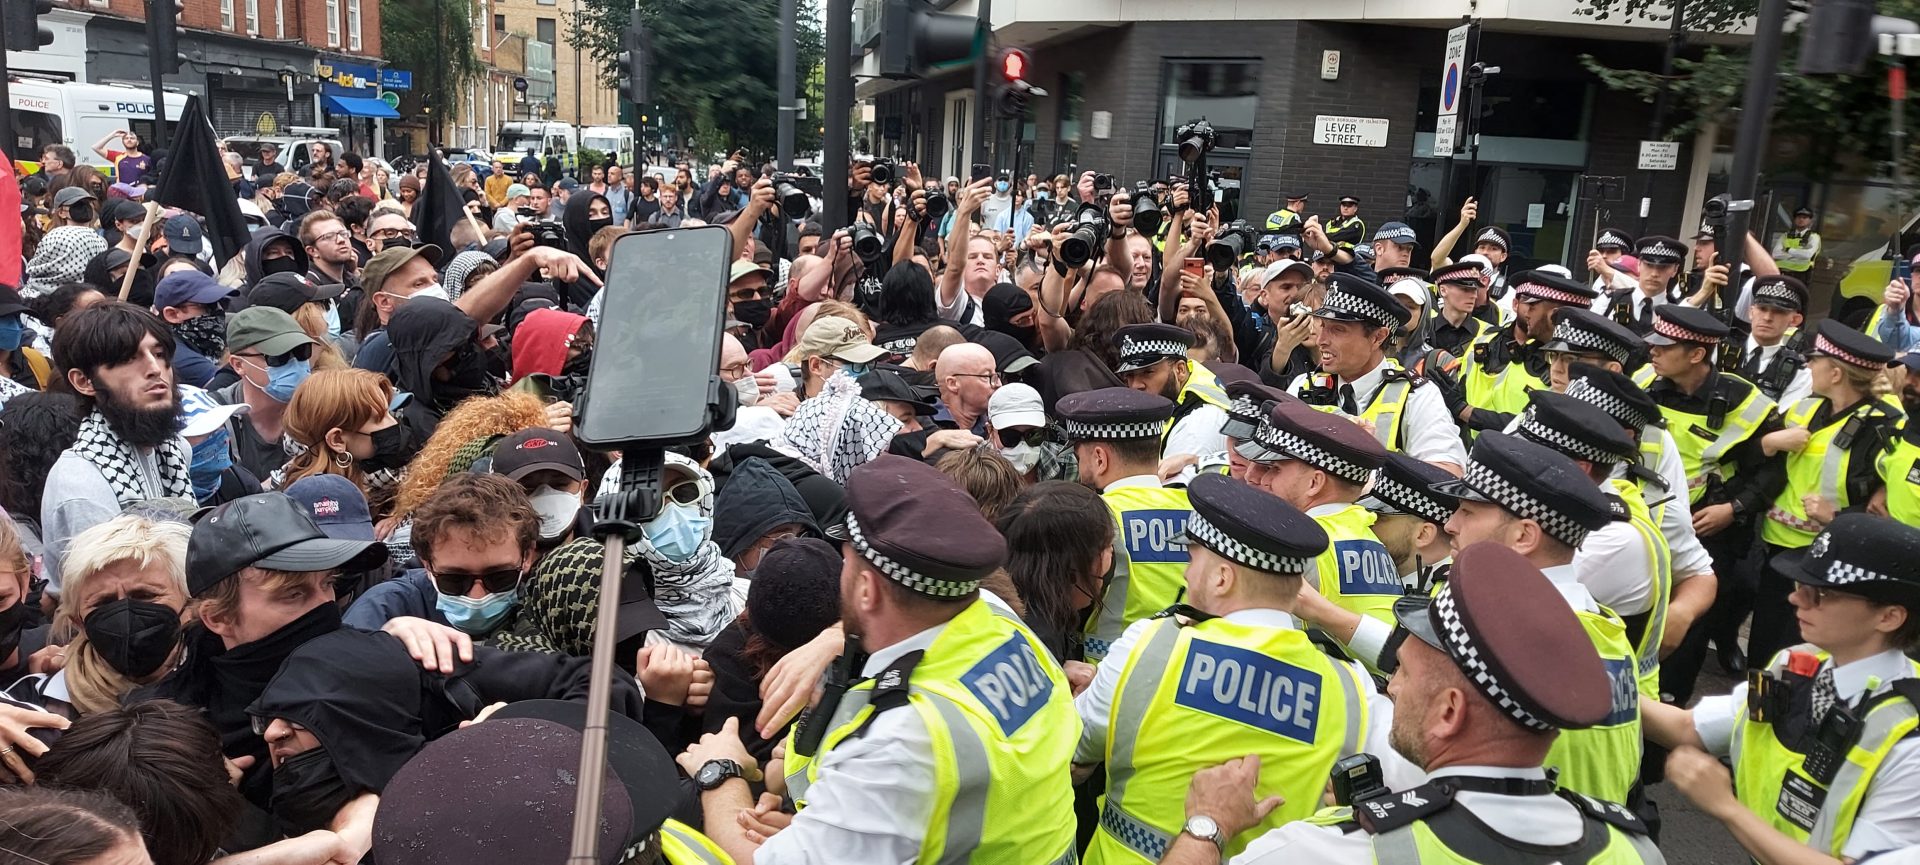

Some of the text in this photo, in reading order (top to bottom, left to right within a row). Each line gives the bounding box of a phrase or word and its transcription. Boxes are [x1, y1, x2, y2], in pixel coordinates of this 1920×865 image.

[1448, 45, 1462, 60] ZONE
[18, 98, 49, 109] POLICE
[1325, 123, 1357, 133] LEVER
[1324, 133, 1362, 144] STREET
[973, 643, 1047, 720] POLI
[1185, 652, 1316, 730] POLICE
